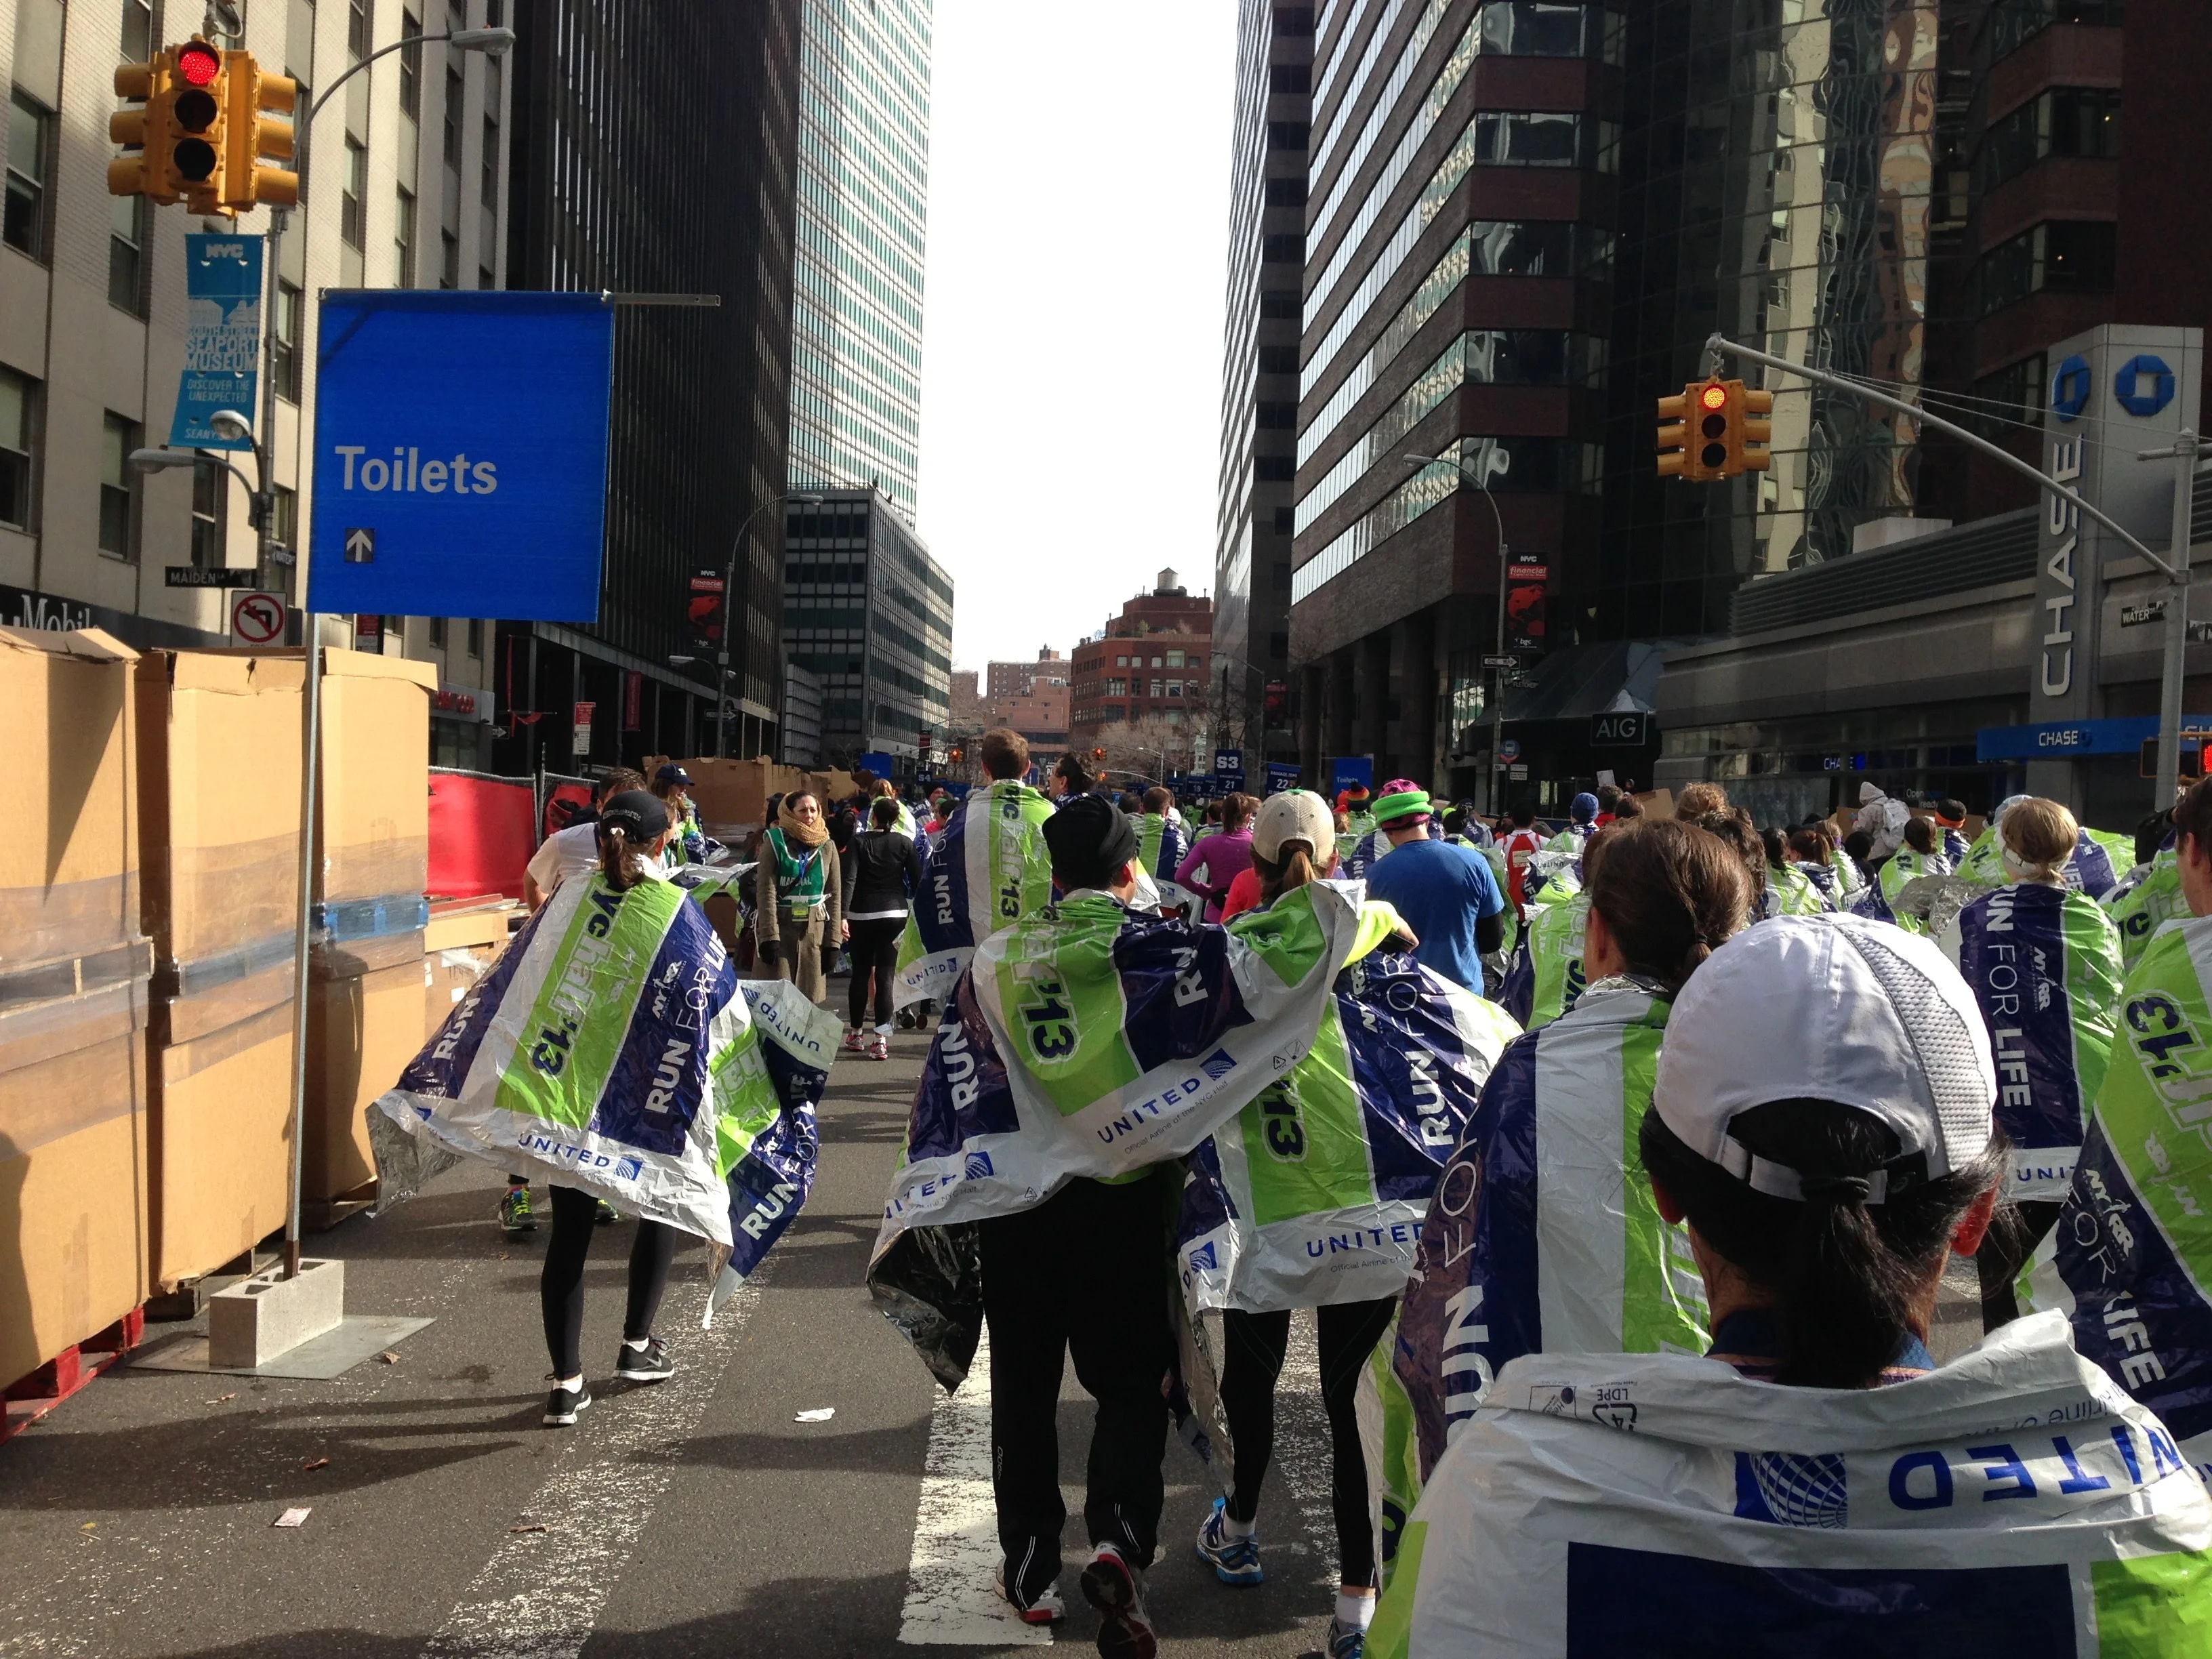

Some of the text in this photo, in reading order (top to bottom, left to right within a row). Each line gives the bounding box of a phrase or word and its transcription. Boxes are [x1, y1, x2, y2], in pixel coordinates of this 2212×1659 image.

[206, 244, 244, 258] NYC
[184, 337, 259, 353] SEAPORT
[186, 352, 258, 372] MUSEUM
[187, 379, 250, 391] DISCOVER THE
[188, 391, 247, 403] UNEXPECTED
[334, 445, 498, 495] Toilets
[1520, 555, 1537, 563] NYC
[2042, 432, 2083, 697] CHASE
[170, 573, 216, 584] MAIDEN
[1509, 566, 1547, 575] financial
[21, 594, 99, 632] Mobil
[2123, 609, 2149, 624] WATER
[1596, 717, 1637, 739] AIG
[2039, 730, 2078, 747] CHASE
[1216, 756, 1239, 769] S3
[918, 774, 931, 782] S4
[1225, 780, 1235, 789] 21
[1276, 778, 1288, 789] 22
[1906, 788, 1925, 798] Open
[1353, 859, 1364, 880] UN
[933, 875, 954, 925] RUN
[532, 883, 625, 1076] ychalf'13
[1988, 945, 2020, 1016] FOR
[432, 995, 480, 1060] RUN
[759, 1002, 820, 1053] UNITED
[644, 1038, 692, 1114] RUN
[675, 967, 717, 1031] FOR
[937, 1020, 980, 1111] RUN
[1995, 1028, 2032, 1108] LIFE
[1405, 1050, 1455, 1147] RUN
[1097, 1077, 1201, 1144] UNITED
[1124, 1137, 1149, 1155] Official
[1149, 1120, 1172, 1141] Airline
[1172, 1112, 1183, 1124] of
[1183, 1105, 1195, 1118] the
[1213, 1080, 1229, 1097] Half
[518, 1132, 609, 1168] UNITED
[2016, 1166, 2076, 1183] UNI
[740, 1180, 798, 1240] RUN
[1331, 1262, 1359, 1273] Official
[1361, 1258, 1387, 1268] Airline
[1441, 1285, 1494, 1414] UN
[1597, 1388, 1628, 1401] LDPE
[1888, 1425, 2184, 1511] NITED
